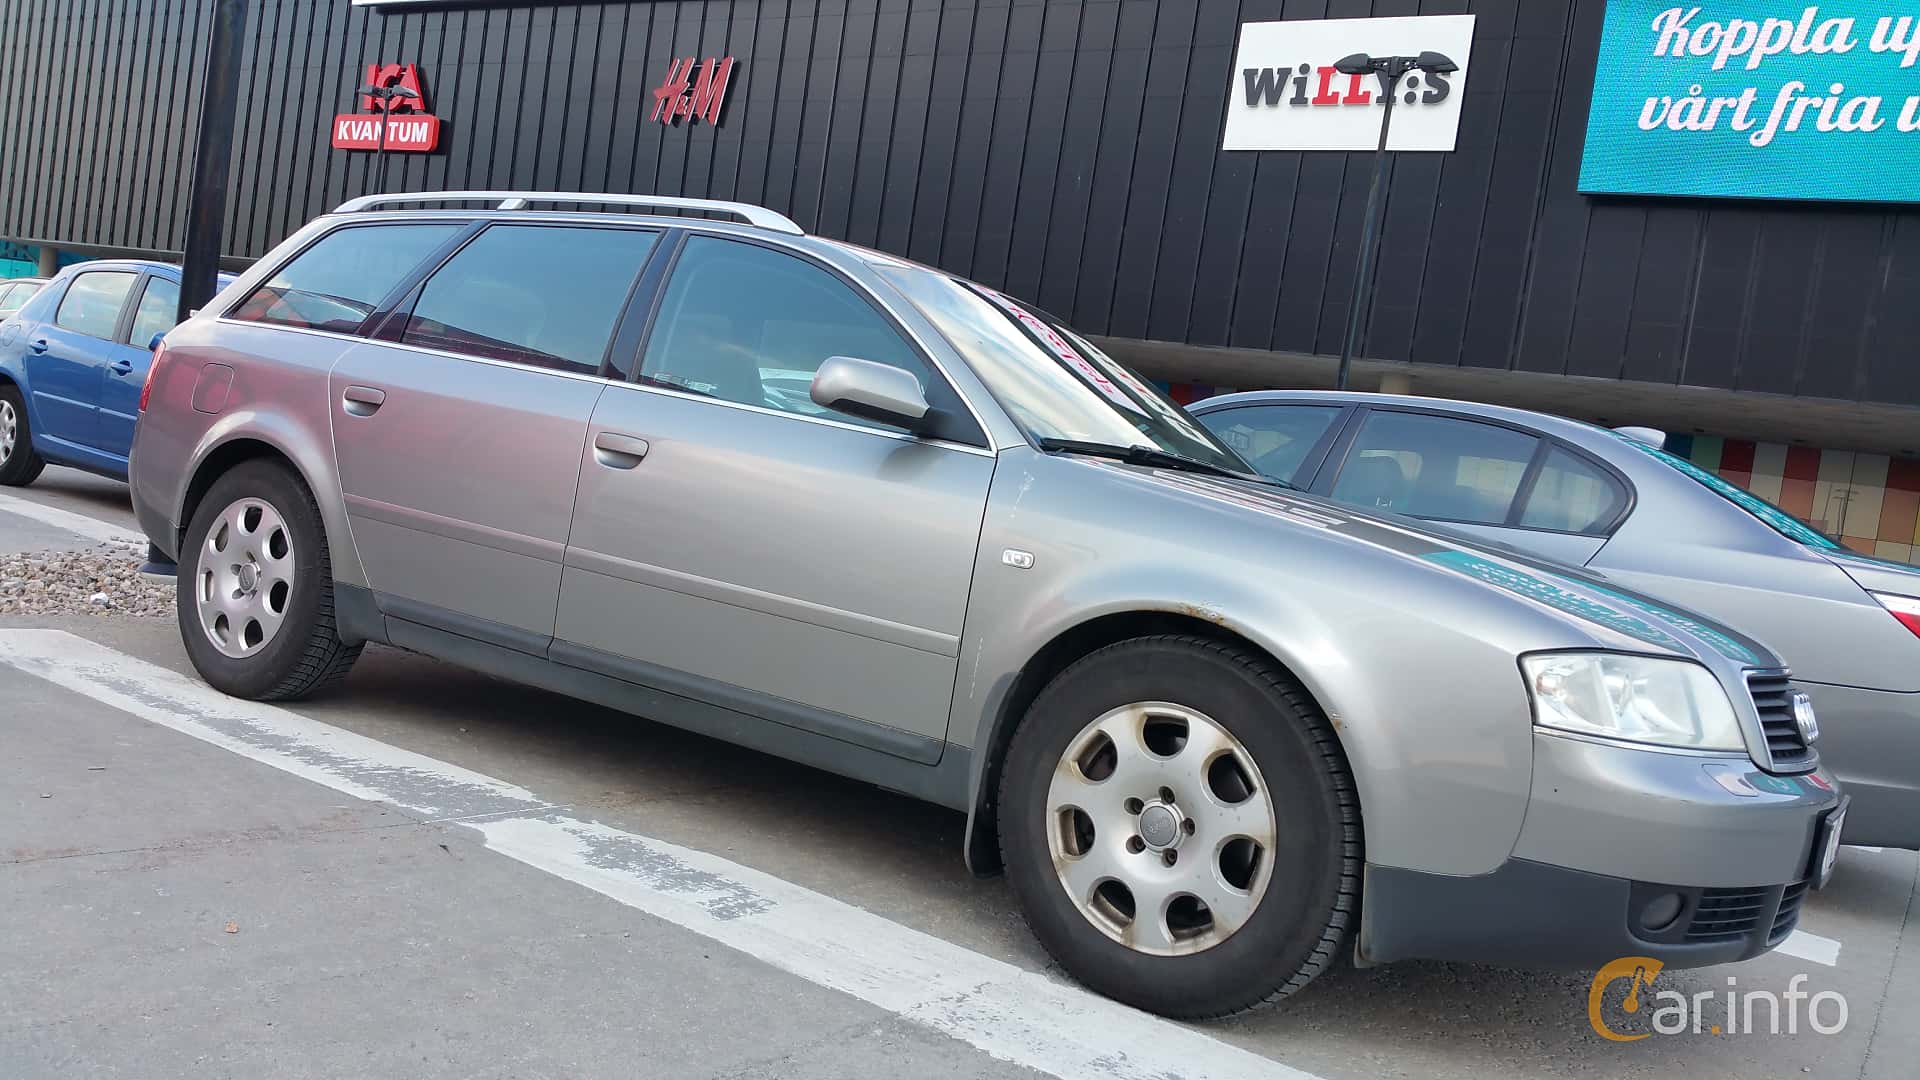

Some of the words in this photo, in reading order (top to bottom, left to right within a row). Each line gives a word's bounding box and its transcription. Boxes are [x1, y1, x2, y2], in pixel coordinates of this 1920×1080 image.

[1651, 6, 1857, 71] Koppla
[362, 63, 425, 111] ICA
[650, 56, 734, 126] H&M
[1638, 84, 1757, 131] vårt
[1749, 80, 1885, 147] fria
